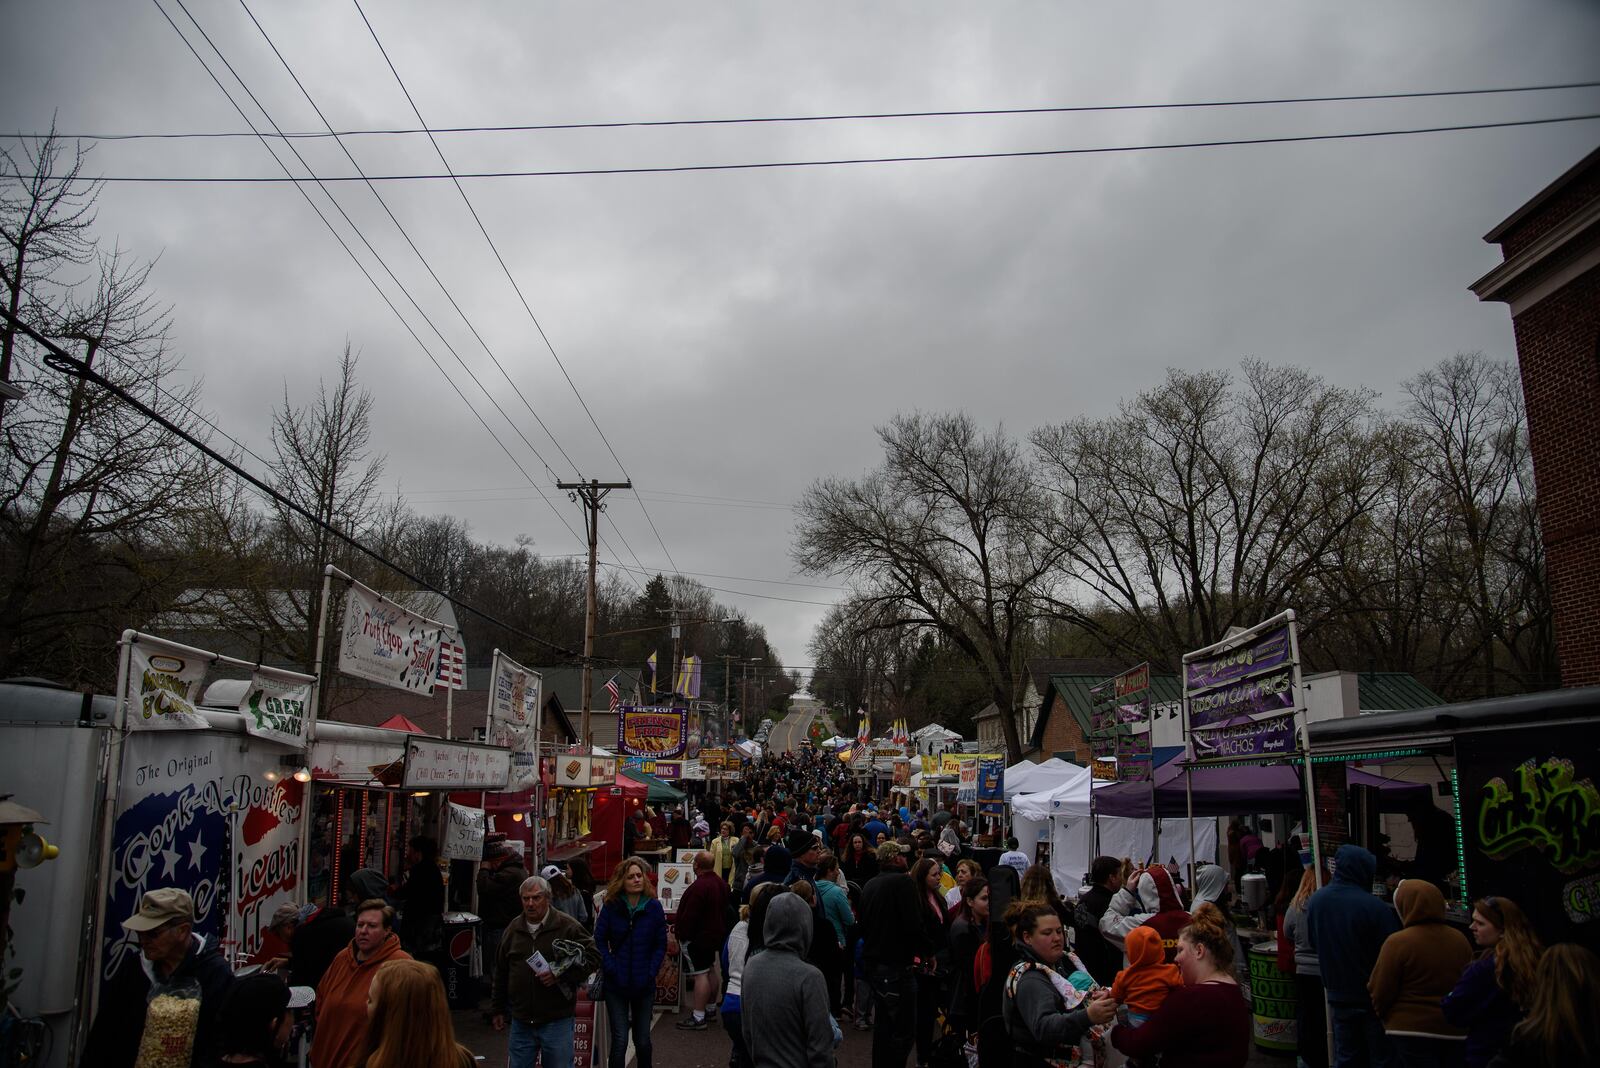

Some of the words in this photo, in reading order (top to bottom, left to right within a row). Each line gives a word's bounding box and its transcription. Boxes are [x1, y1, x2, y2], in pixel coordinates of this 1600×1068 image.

[627, 715, 679, 730] FRENCH
[635, 727, 669, 739] FRIES
[136, 764, 160, 786] The
[167, 751, 213, 777] Original
[1250, 959, 1283, 979] GRA
[447, 967, 458, 1000] pepsi
[1255, 997, 1297, 1019] DEW
[573, 1037, 588, 1050] ries
